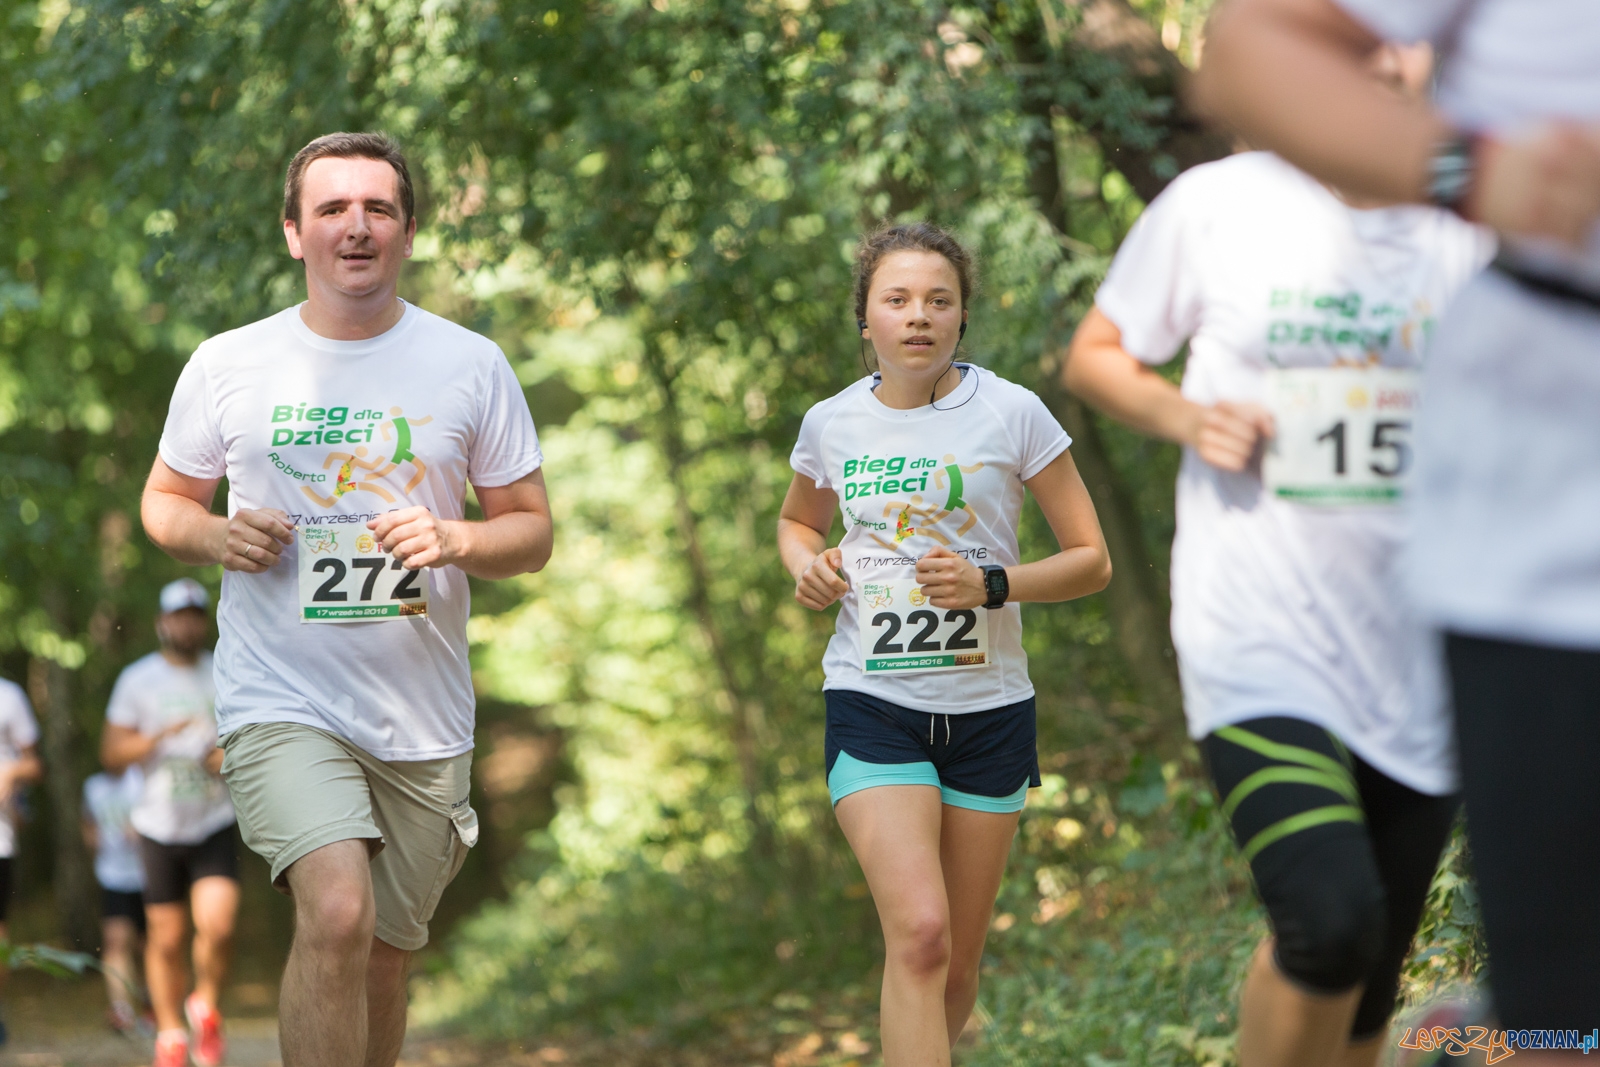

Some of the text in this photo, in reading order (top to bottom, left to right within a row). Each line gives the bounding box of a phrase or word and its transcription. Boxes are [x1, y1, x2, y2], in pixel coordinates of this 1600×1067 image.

[271, 402, 383, 426] Bieg dla
[271, 423, 375, 447] Dzieci
[267, 452, 326, 482] Roberta
[844, 455, 937, 479] Bieg dla
[845, 471, 929, 501] Dzieci
[855, 557, 871, 570] 17
[312, 557, 422, 602] 272
[363, 607, 388, 615] 2016
[871, 609, 978, 655] 222
[919, 658, 943, 666] 2016
